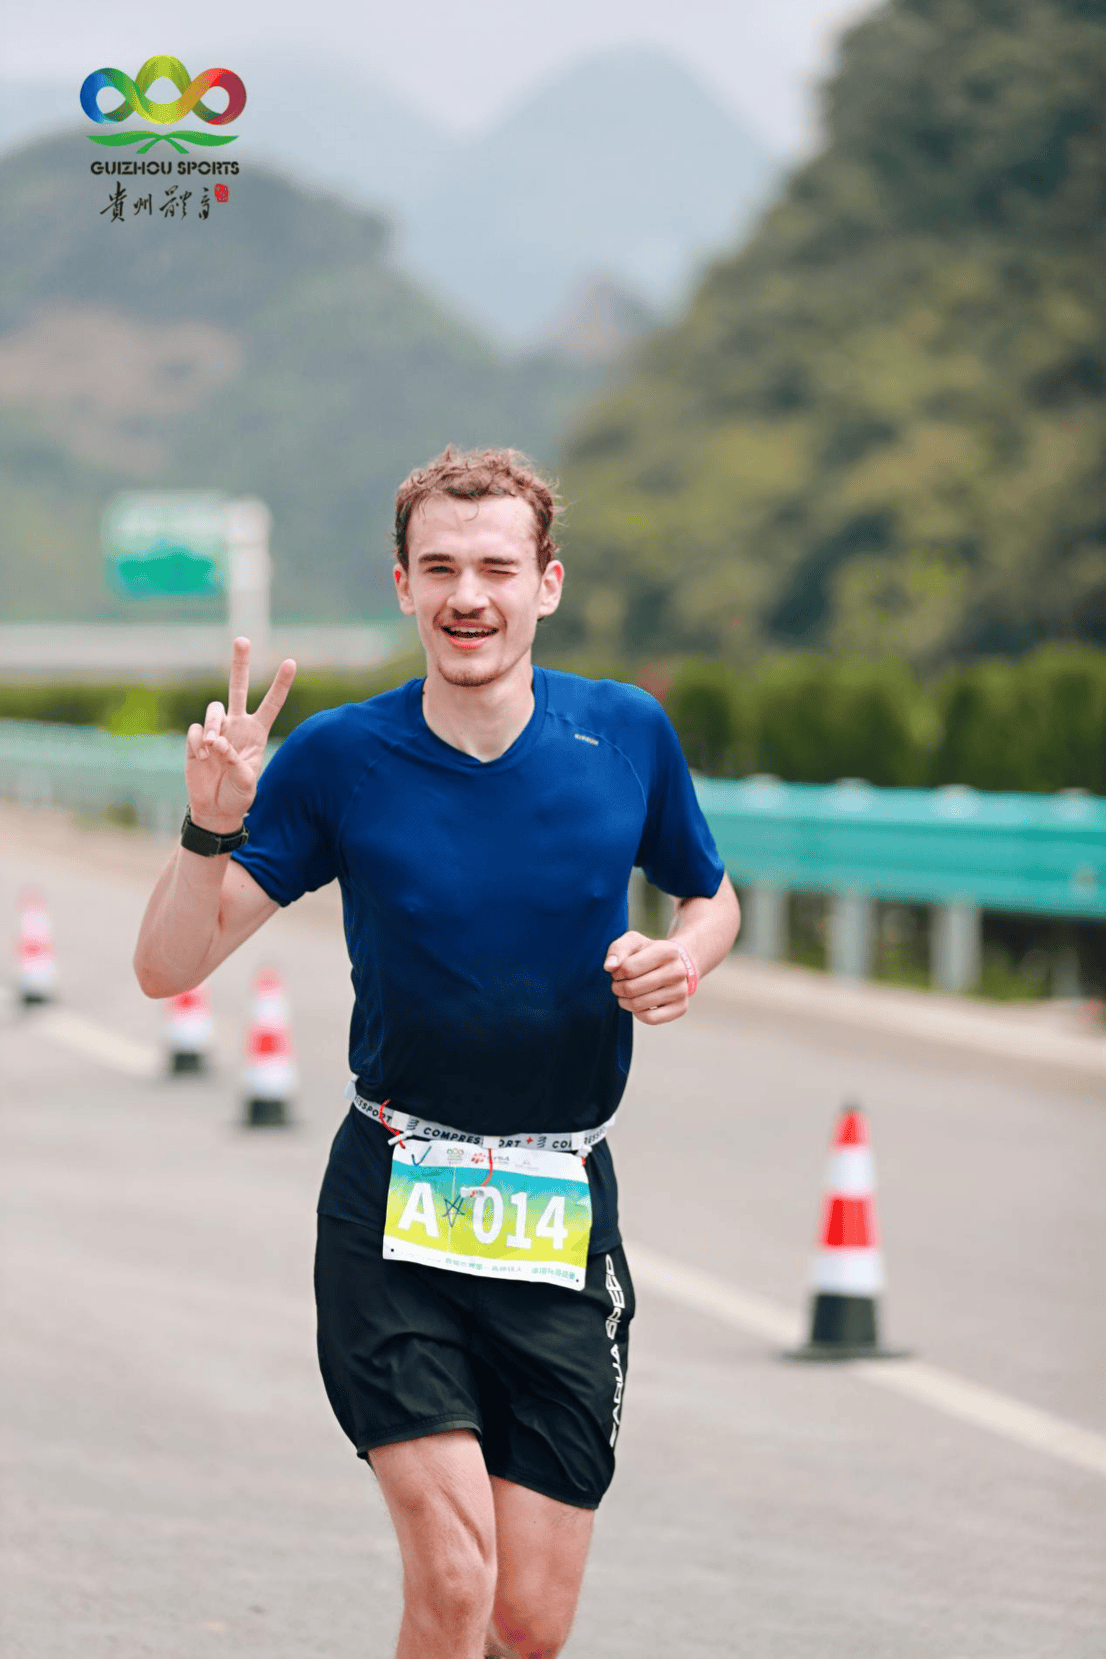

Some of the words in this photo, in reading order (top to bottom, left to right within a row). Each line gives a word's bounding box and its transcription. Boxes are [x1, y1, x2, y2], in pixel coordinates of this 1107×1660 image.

[398, 1182, 440, 1238] A
[471, 1186, 568, 1250] 014
[605, 1253, 626, 1340] SPEED
